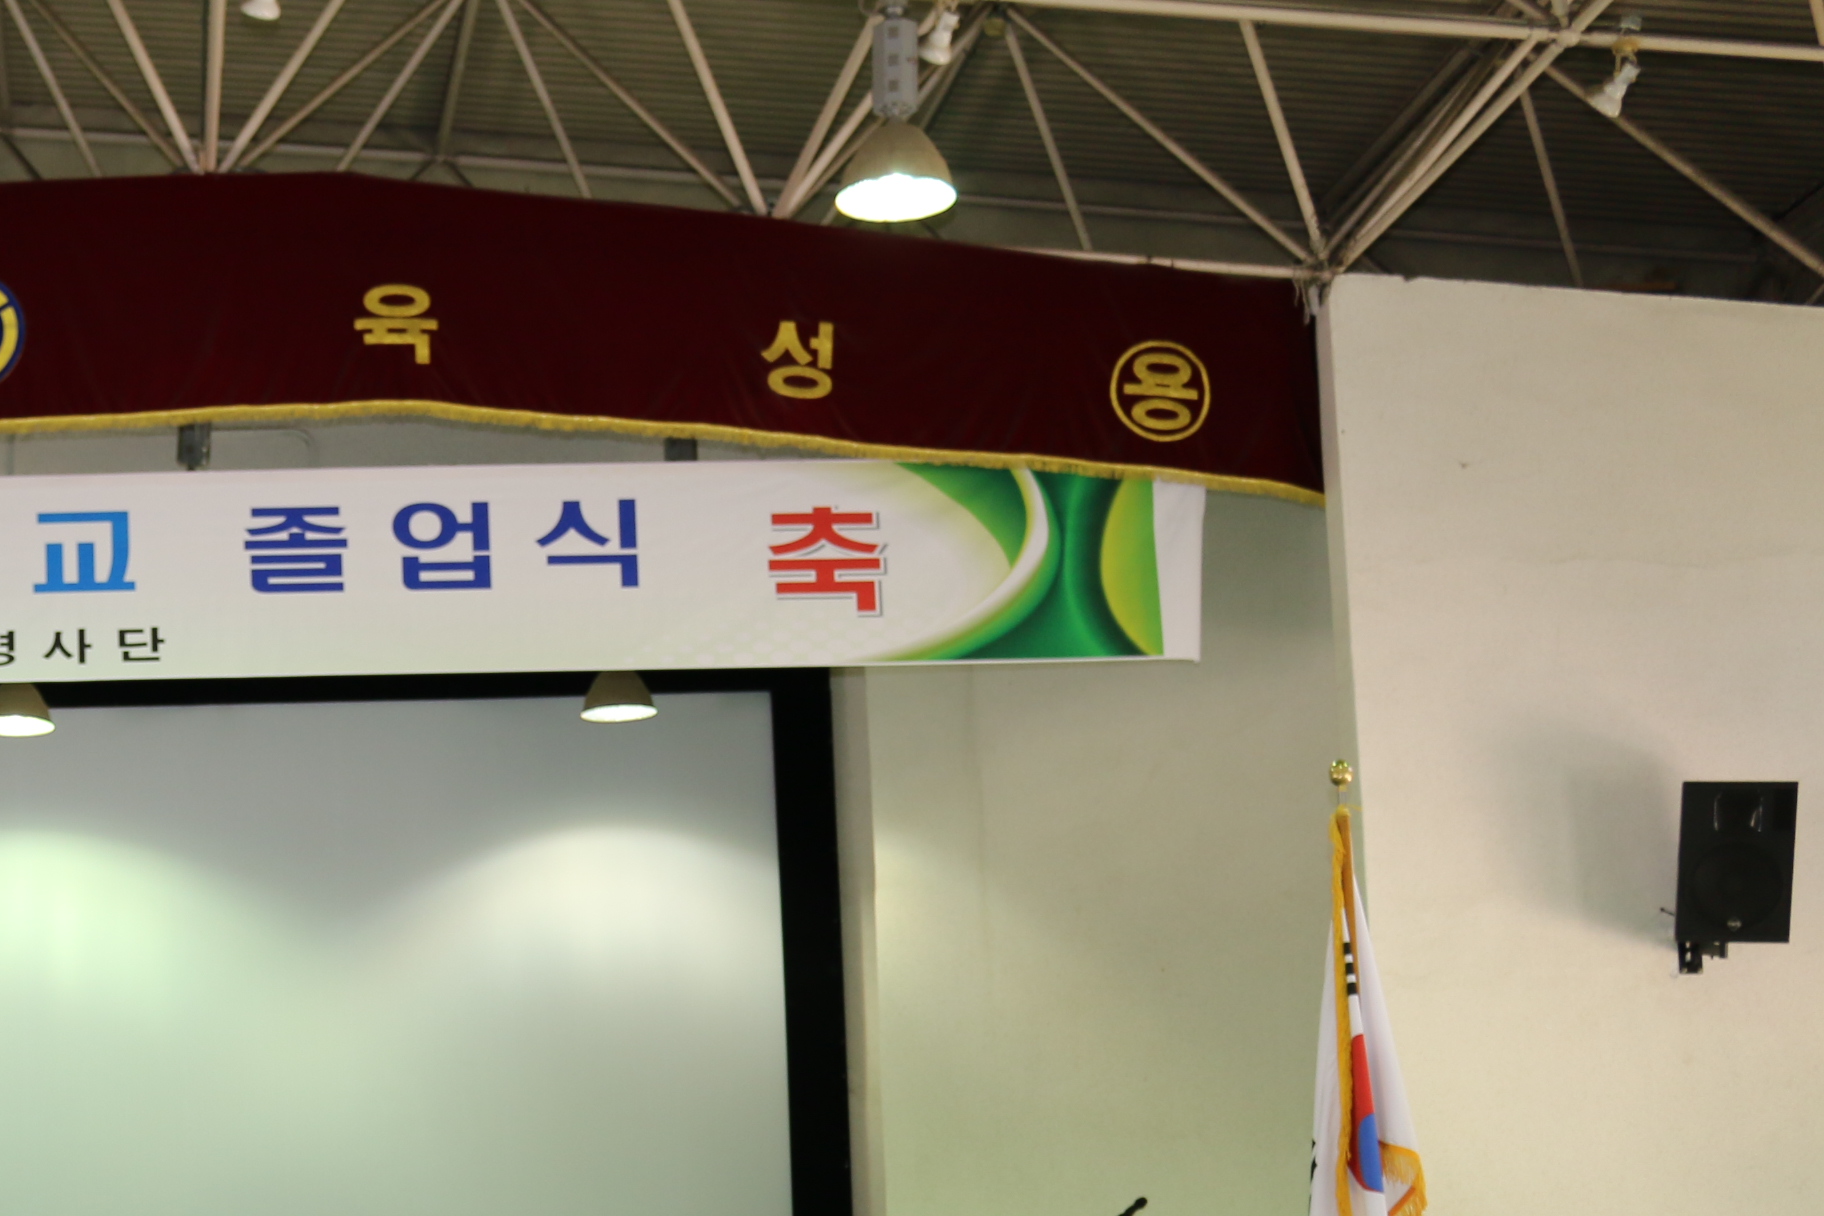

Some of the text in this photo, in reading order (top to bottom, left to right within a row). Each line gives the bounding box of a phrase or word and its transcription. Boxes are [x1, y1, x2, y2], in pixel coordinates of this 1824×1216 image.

[353, 283, 441, 366] 육
[760, 319, 836, 400] 성
[1120, 350, 1201, 434] 용
[244, 499, 639, 593] 졸업식
[768, 506, 885, 616] 축
